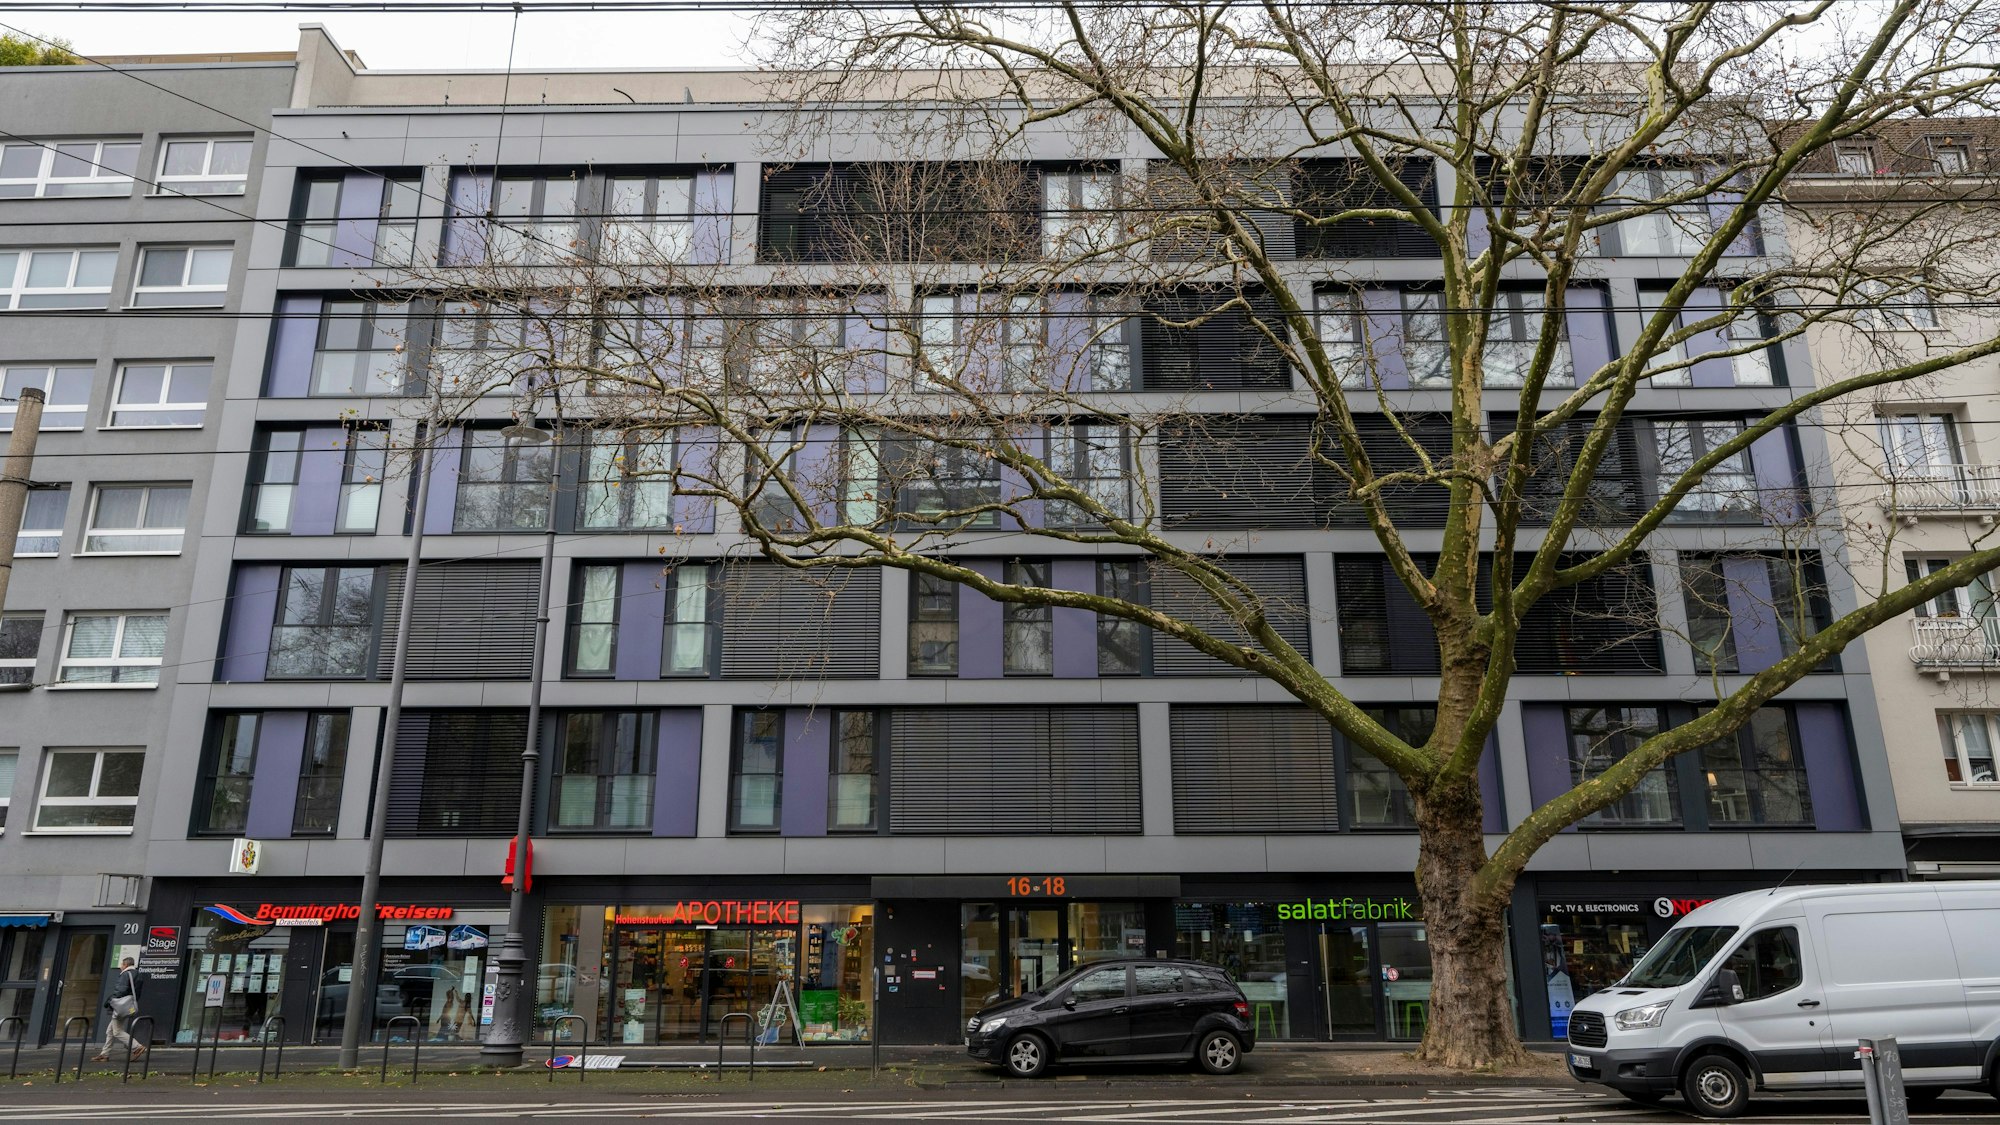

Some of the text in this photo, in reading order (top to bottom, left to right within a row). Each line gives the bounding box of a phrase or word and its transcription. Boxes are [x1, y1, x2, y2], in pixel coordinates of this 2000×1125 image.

[256, 903, 453, 922] Benningho Reisen
[615, 901, 799, 925] Hohenstaufen APOTHEKE
[1277, 897, 1414, 920] salatfabrik
[1550, 904, 1640, 913] PC, TV & ELECTRONICS
[1657, 898, 1713, 916] SNO
[123, 923, 139, 935] 20
[149, 938, 177, 950] Stage
